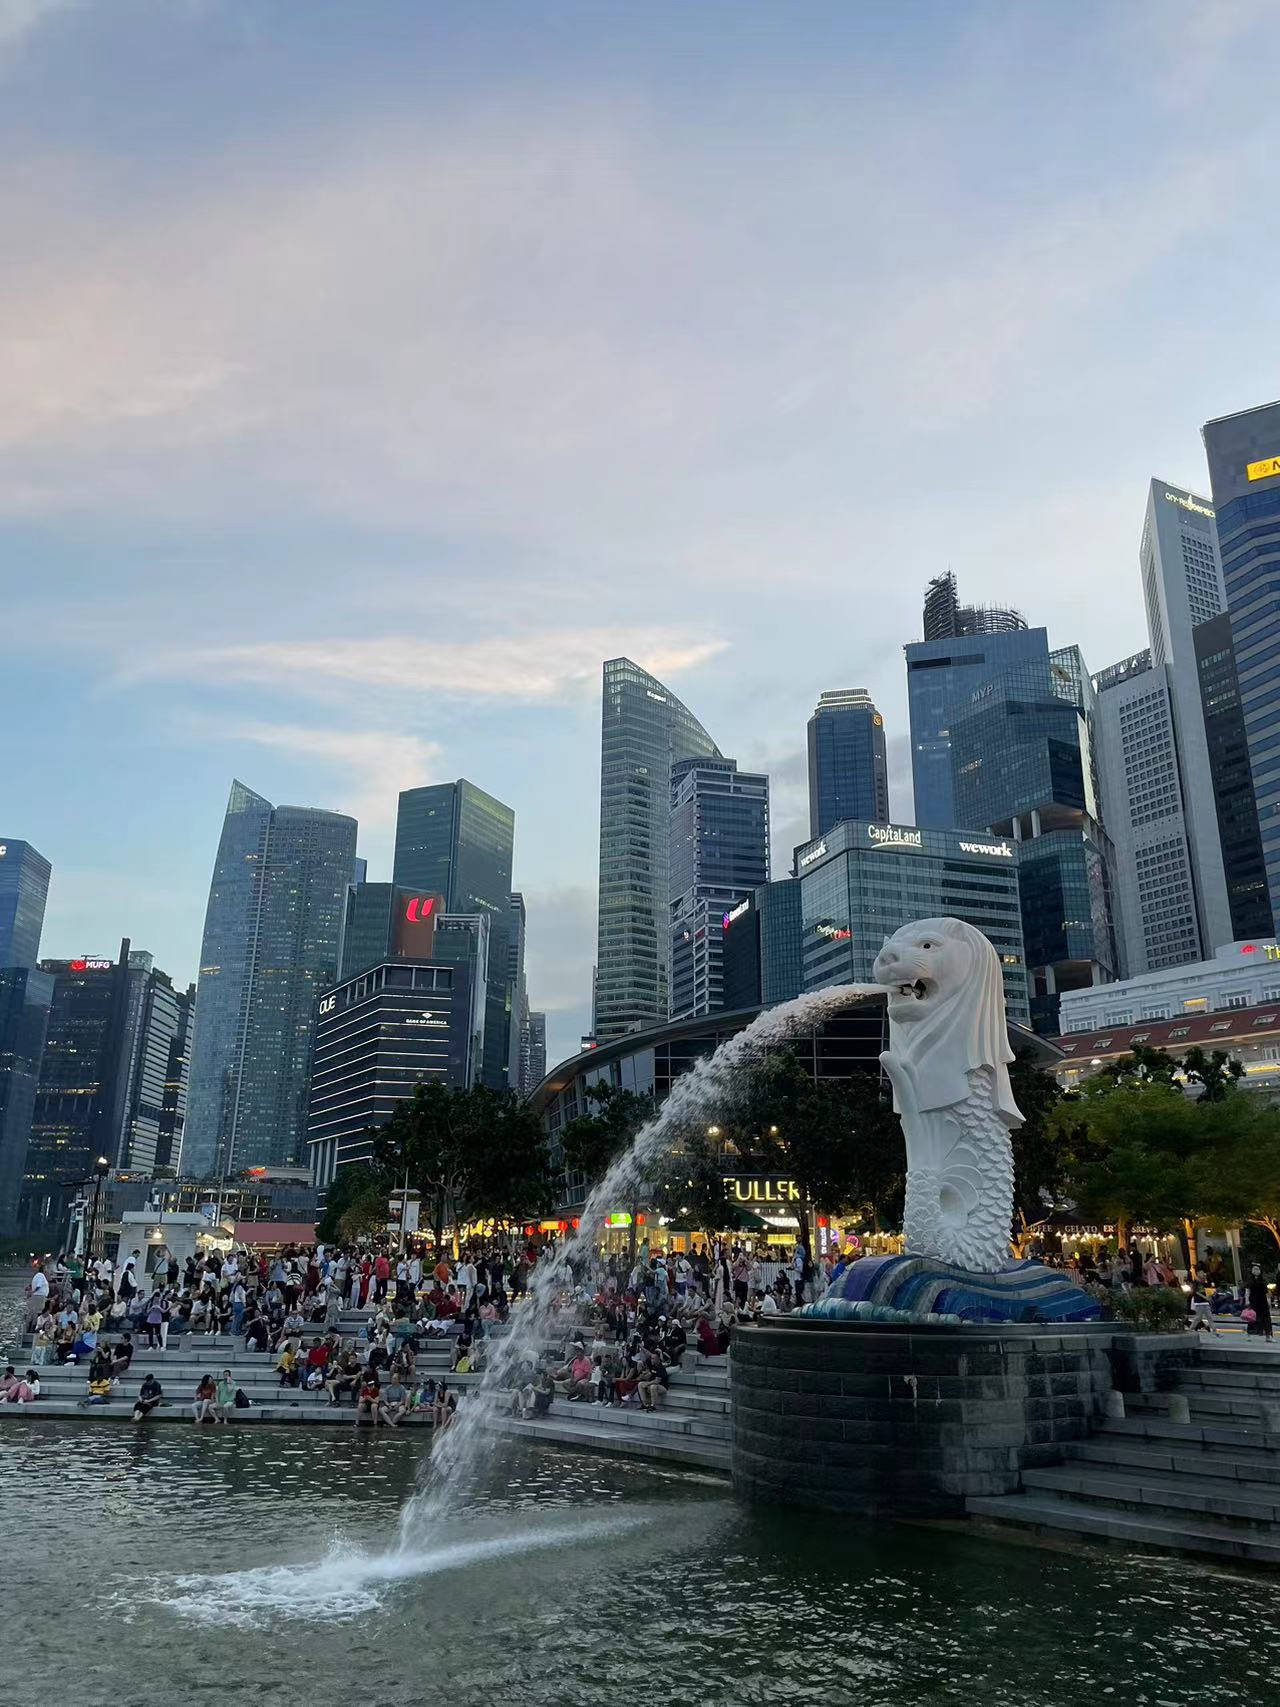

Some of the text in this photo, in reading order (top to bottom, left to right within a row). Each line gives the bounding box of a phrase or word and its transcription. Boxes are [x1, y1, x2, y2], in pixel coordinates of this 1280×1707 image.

[971, 684, 994, 703] MYP
[868, 824, 921, 844] CapitaLand
[801, 841, 827, 867] wework
[959, 841, 1013, 857] wework
[86, 961, 110, 969] MUFG
[319, 995, 337, 1015] OUE
[723, 1177, 801, 1201] FULLER
[1064, 1225, 1098, 1234] GELATO
